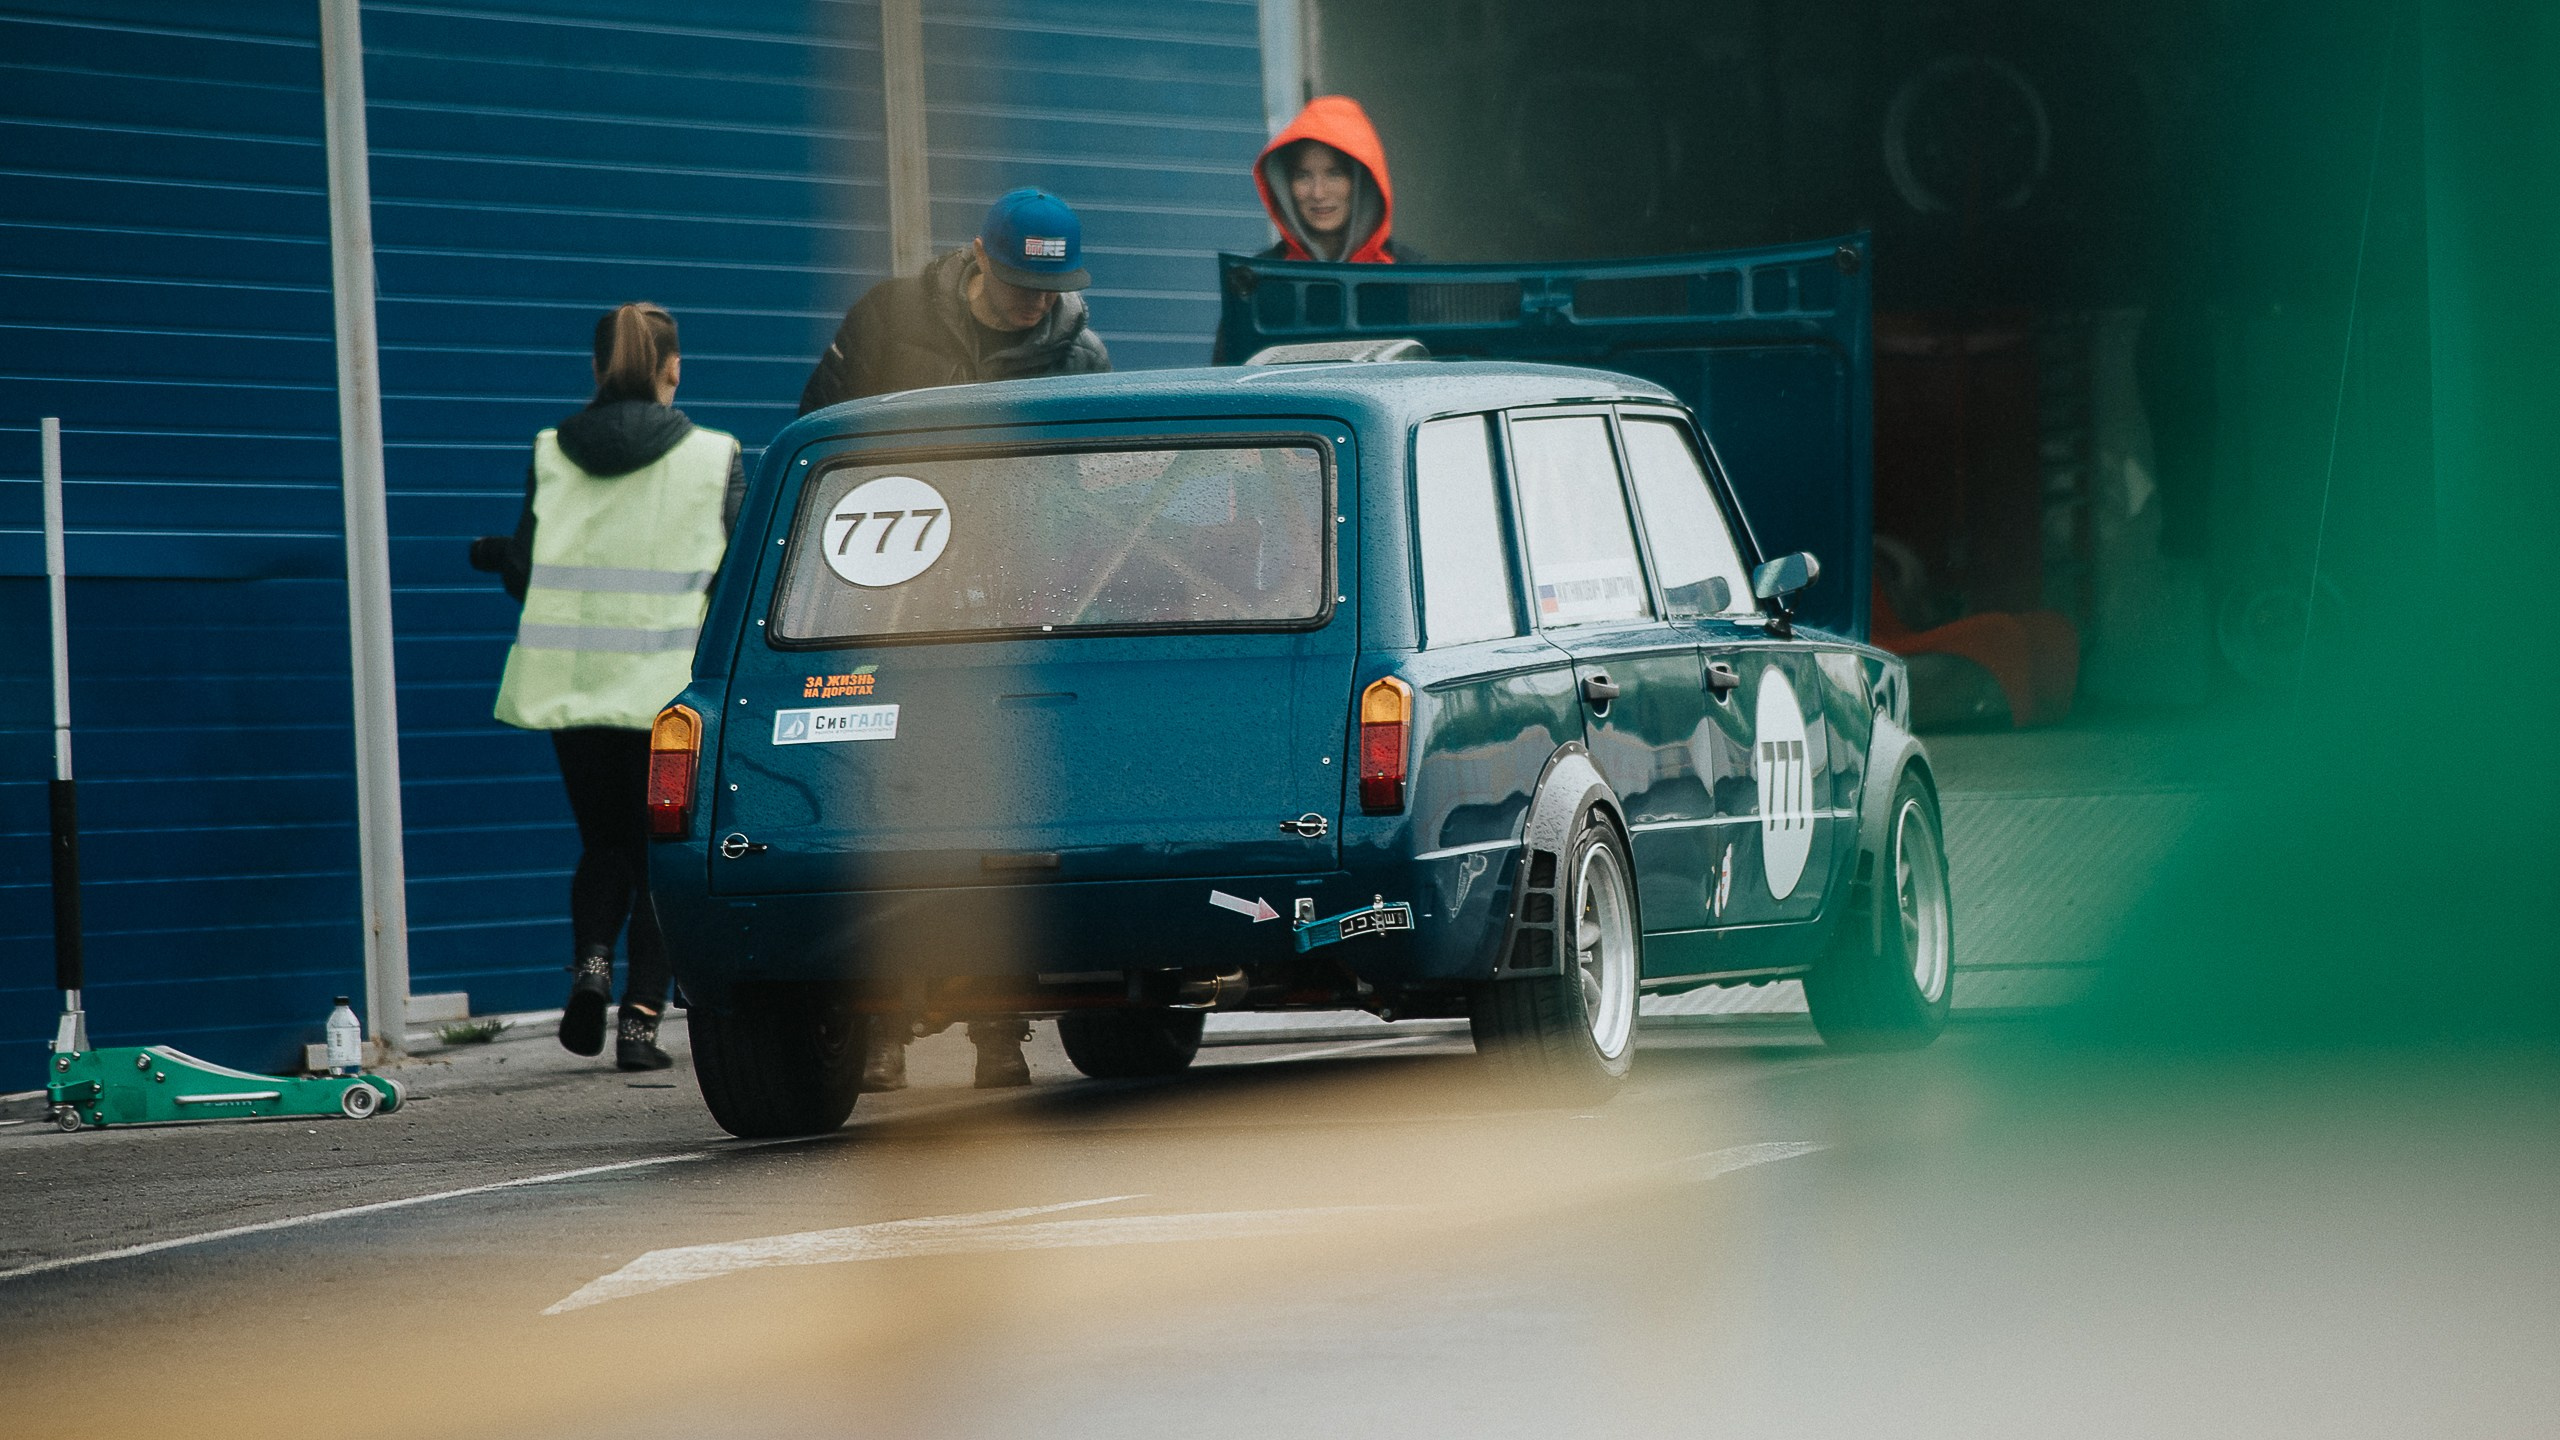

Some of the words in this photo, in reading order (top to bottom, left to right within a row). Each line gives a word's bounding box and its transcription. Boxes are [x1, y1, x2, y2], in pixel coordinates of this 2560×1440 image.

[835, 508, 944, 556] 777
[803, 688, 819, 698] НА
[821, 685, 874, 698] ДОРОГАХ
[805, 676, 823, 688] ЗА
[826, 673, 876, 687] ЖИЗНЬ
[1760, 740, 1805, 832] 777
